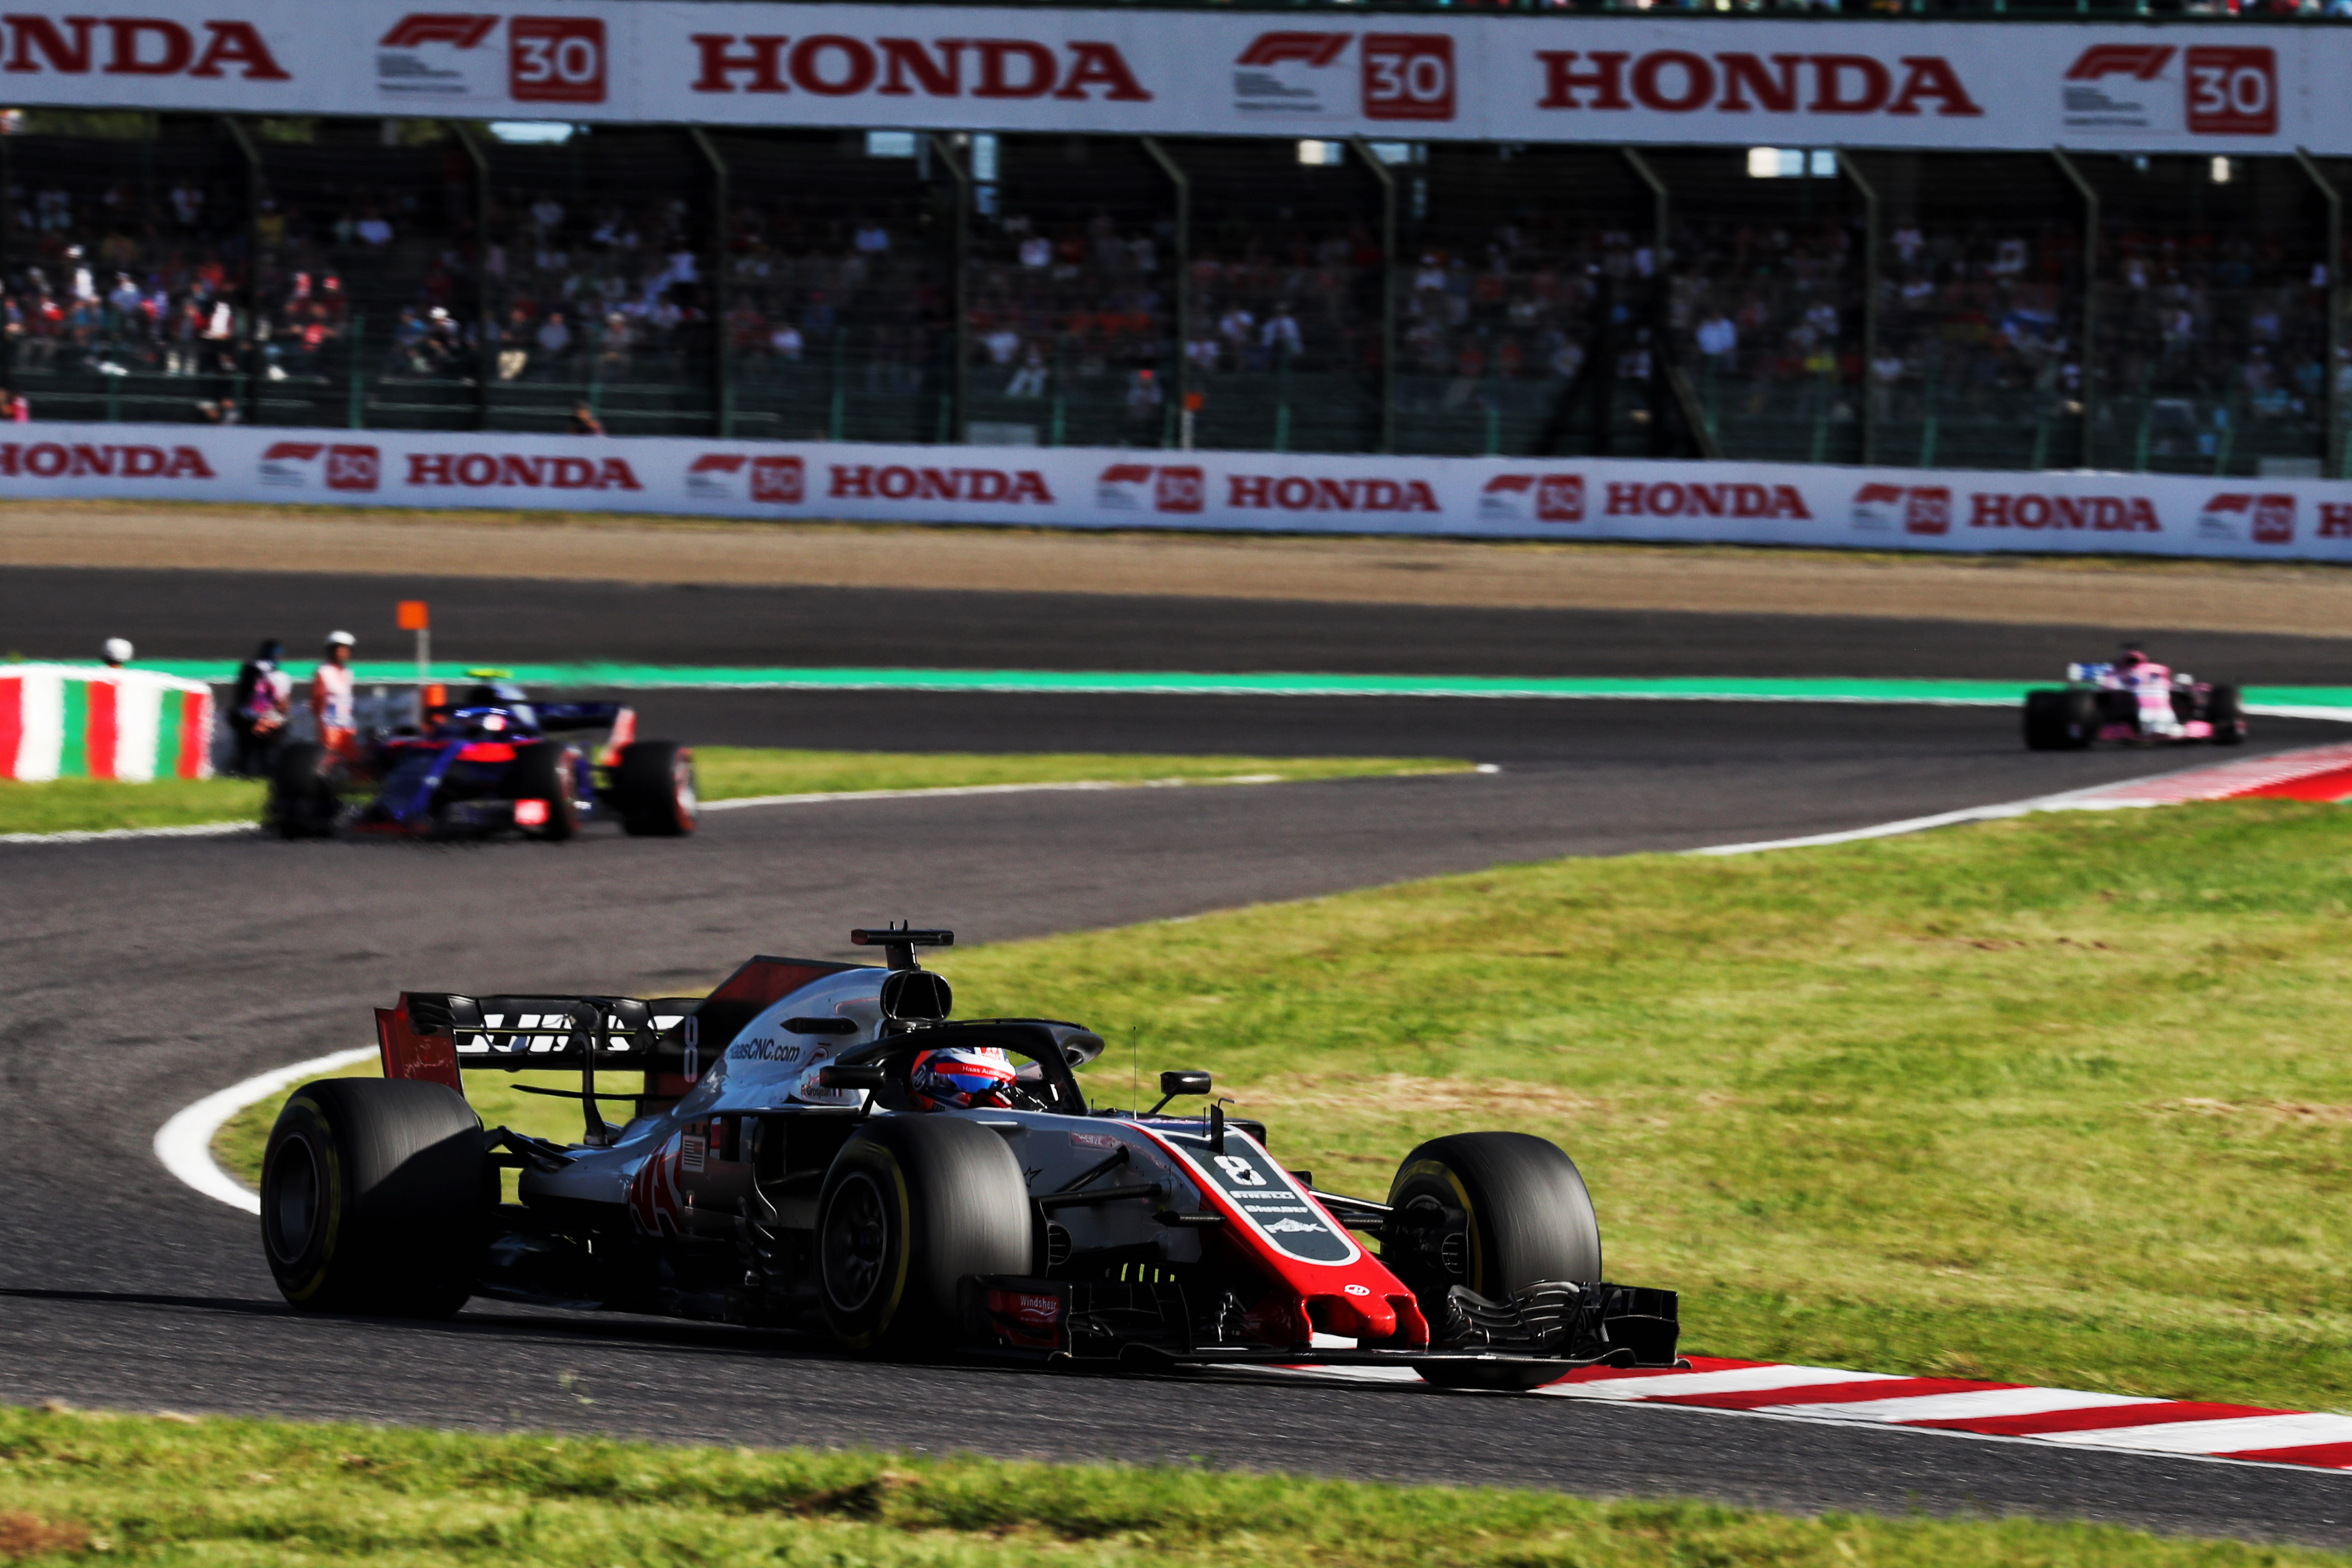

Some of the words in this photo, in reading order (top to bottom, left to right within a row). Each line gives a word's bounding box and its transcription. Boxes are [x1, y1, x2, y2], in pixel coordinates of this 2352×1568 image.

[0, 15, 291, 80] NDA
[517, 37, 597, 83] 30
[691, 34, 1153, 102] HONDA
[1369, 54, 1446, 101] 30
[1534, 49, 1984, 117] HONDA
[2193, 66, 2269, 114] 30
[406, 453, 643, 490] HONDA
[828, 466, 1054, 504] HONDA
[1228, 475, 1440, 512] HONDA
[1605, 482, 1812, 519] HONDA
[1969, 493, 2161, 532] HONDA
[684, 1015, 698, 1083] 8
[962, 1065, 980, 1073] Haas
[1020, 1295, 1057, 1310] Windshear
